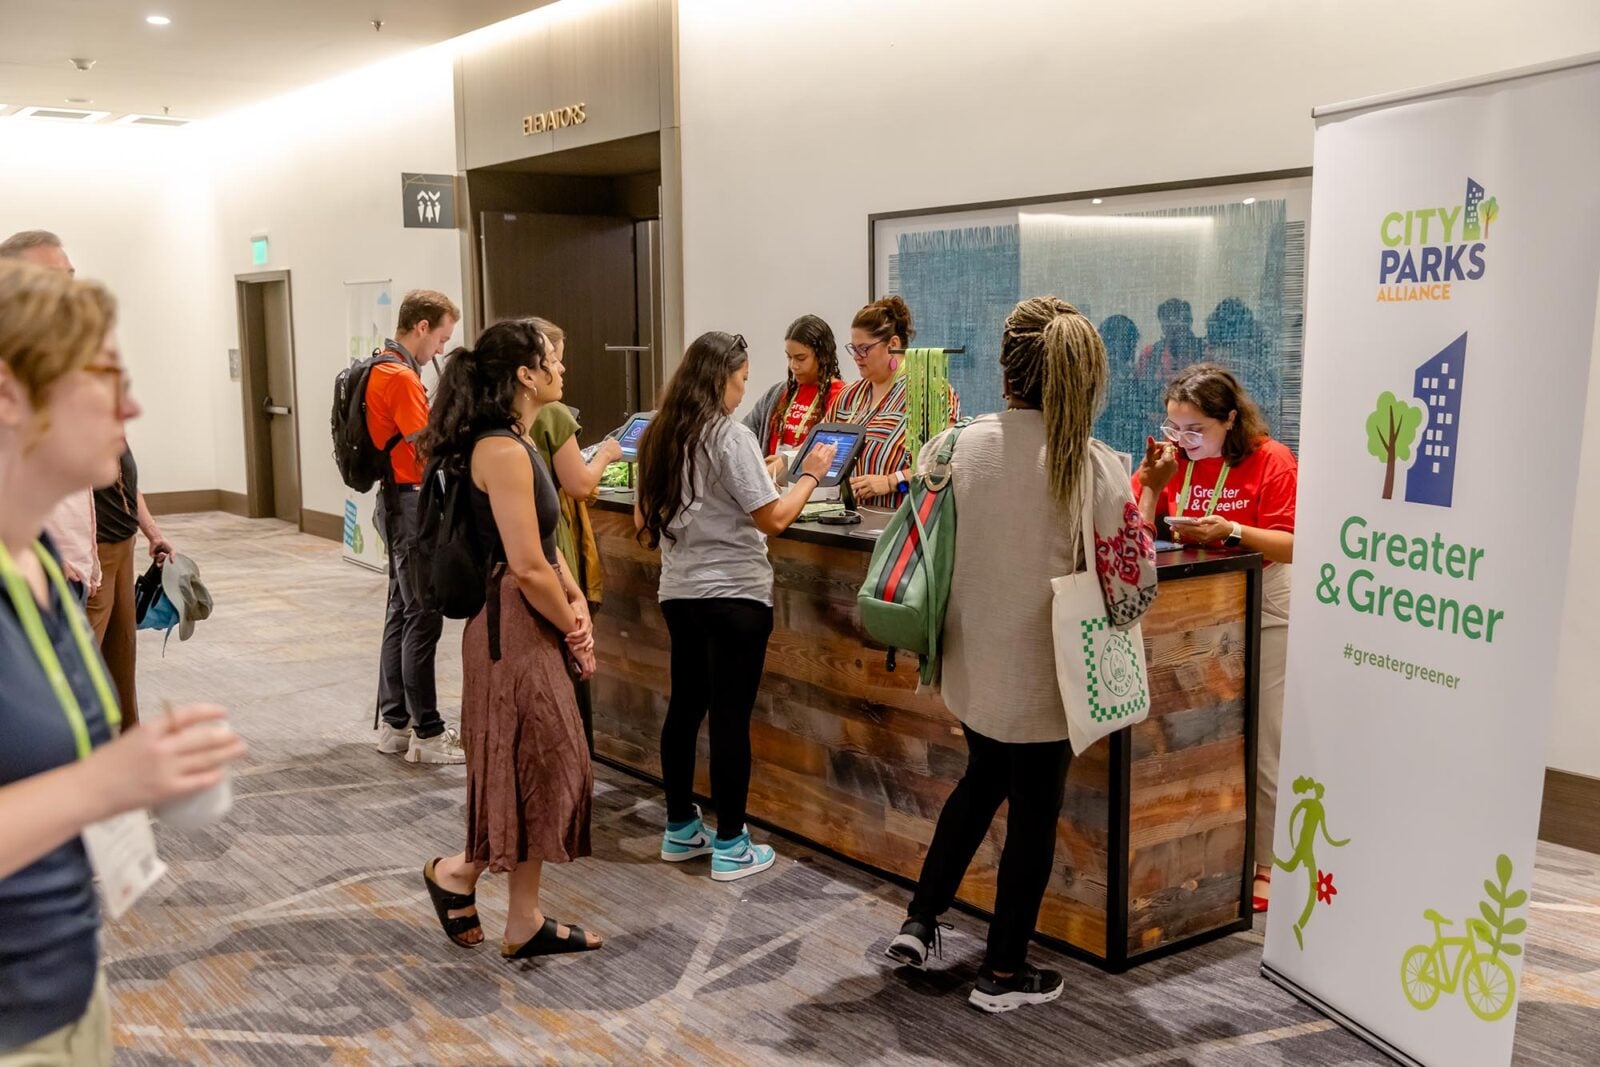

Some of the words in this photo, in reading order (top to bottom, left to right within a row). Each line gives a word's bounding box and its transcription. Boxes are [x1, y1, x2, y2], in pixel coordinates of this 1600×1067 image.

[522, 102, 586, 136] ELEVATORS
[1380, 206, 1462, 247] CITY
[1379, 243, 1486, 284] PARKS
[1376, 284, 1451, 302] ALLIANCE
[1193, 484, 1240, 499] Greter
[1201, 499, 1250, 512] Geeer
[1340, 516, 1485, 581] Greater
[1343, 643, 1461, 690] #greatergreener
